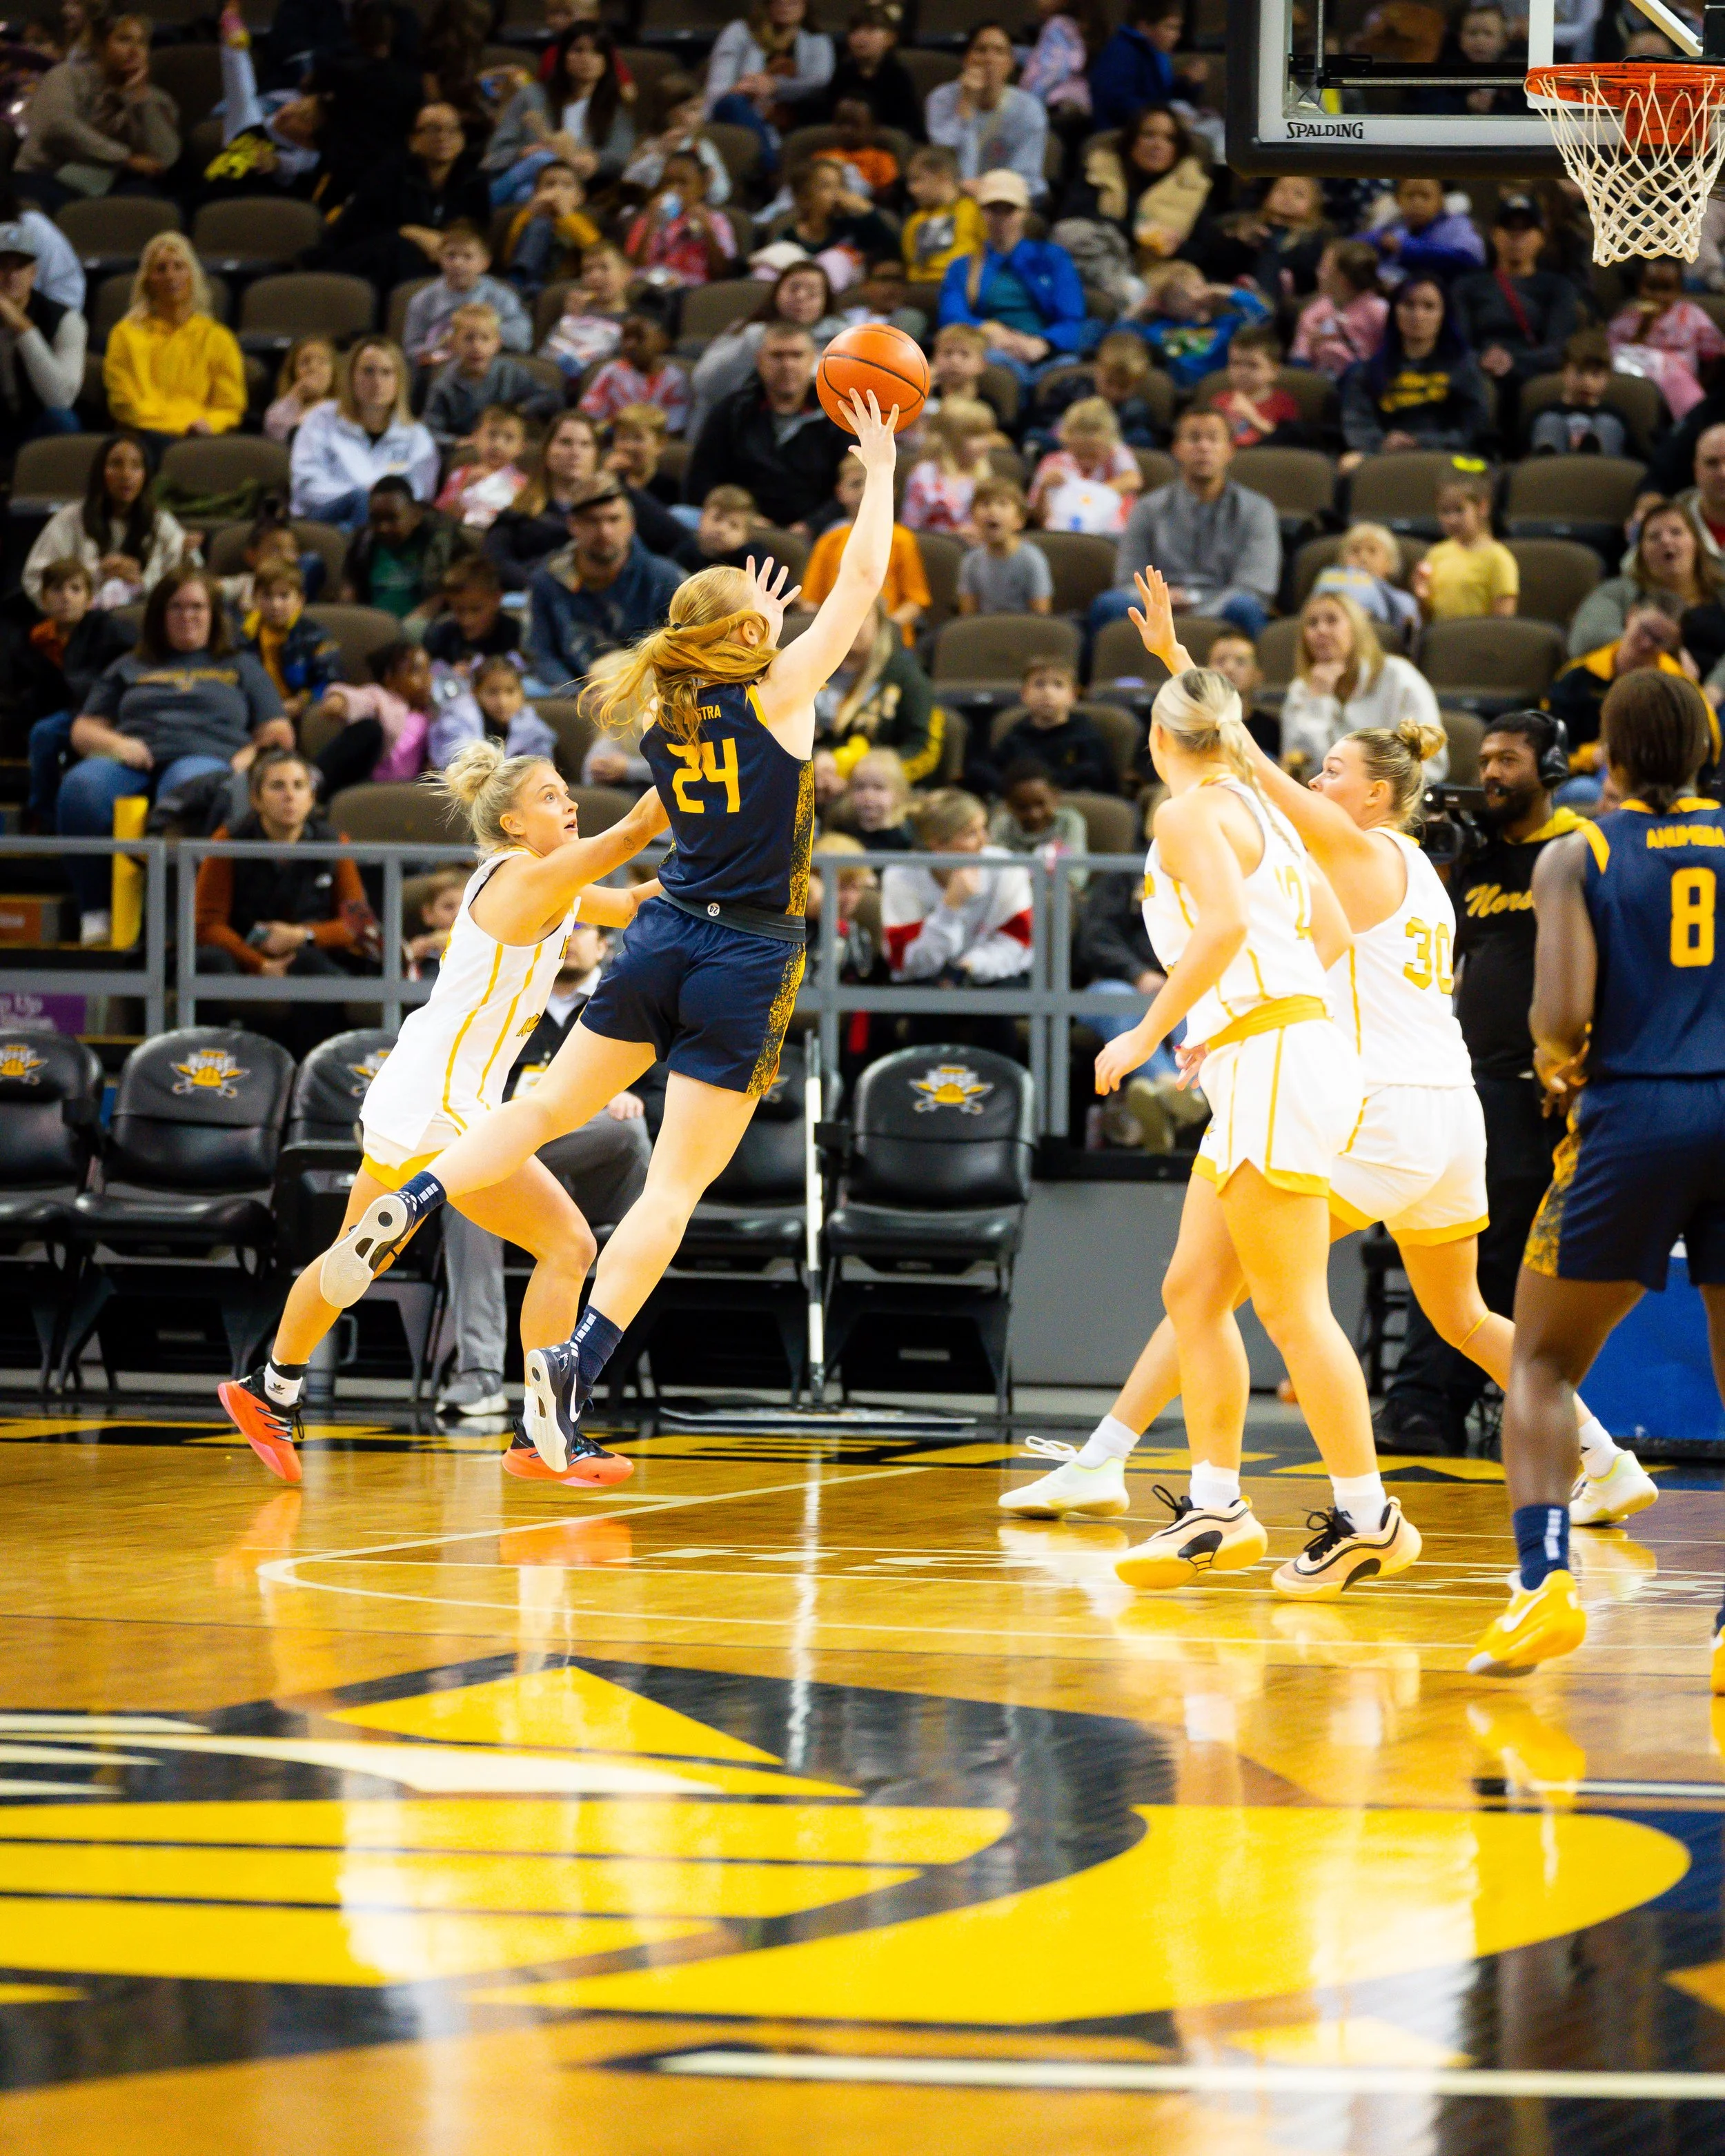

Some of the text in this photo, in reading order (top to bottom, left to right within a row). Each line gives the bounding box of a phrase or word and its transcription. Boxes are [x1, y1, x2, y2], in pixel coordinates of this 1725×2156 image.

[1286, 121, 1364, 139] SPALDING
[667, 738, 740, 813] 24
[1670, 867, 1717, 968] 8
[1403, 917, 1454, 996] 30
